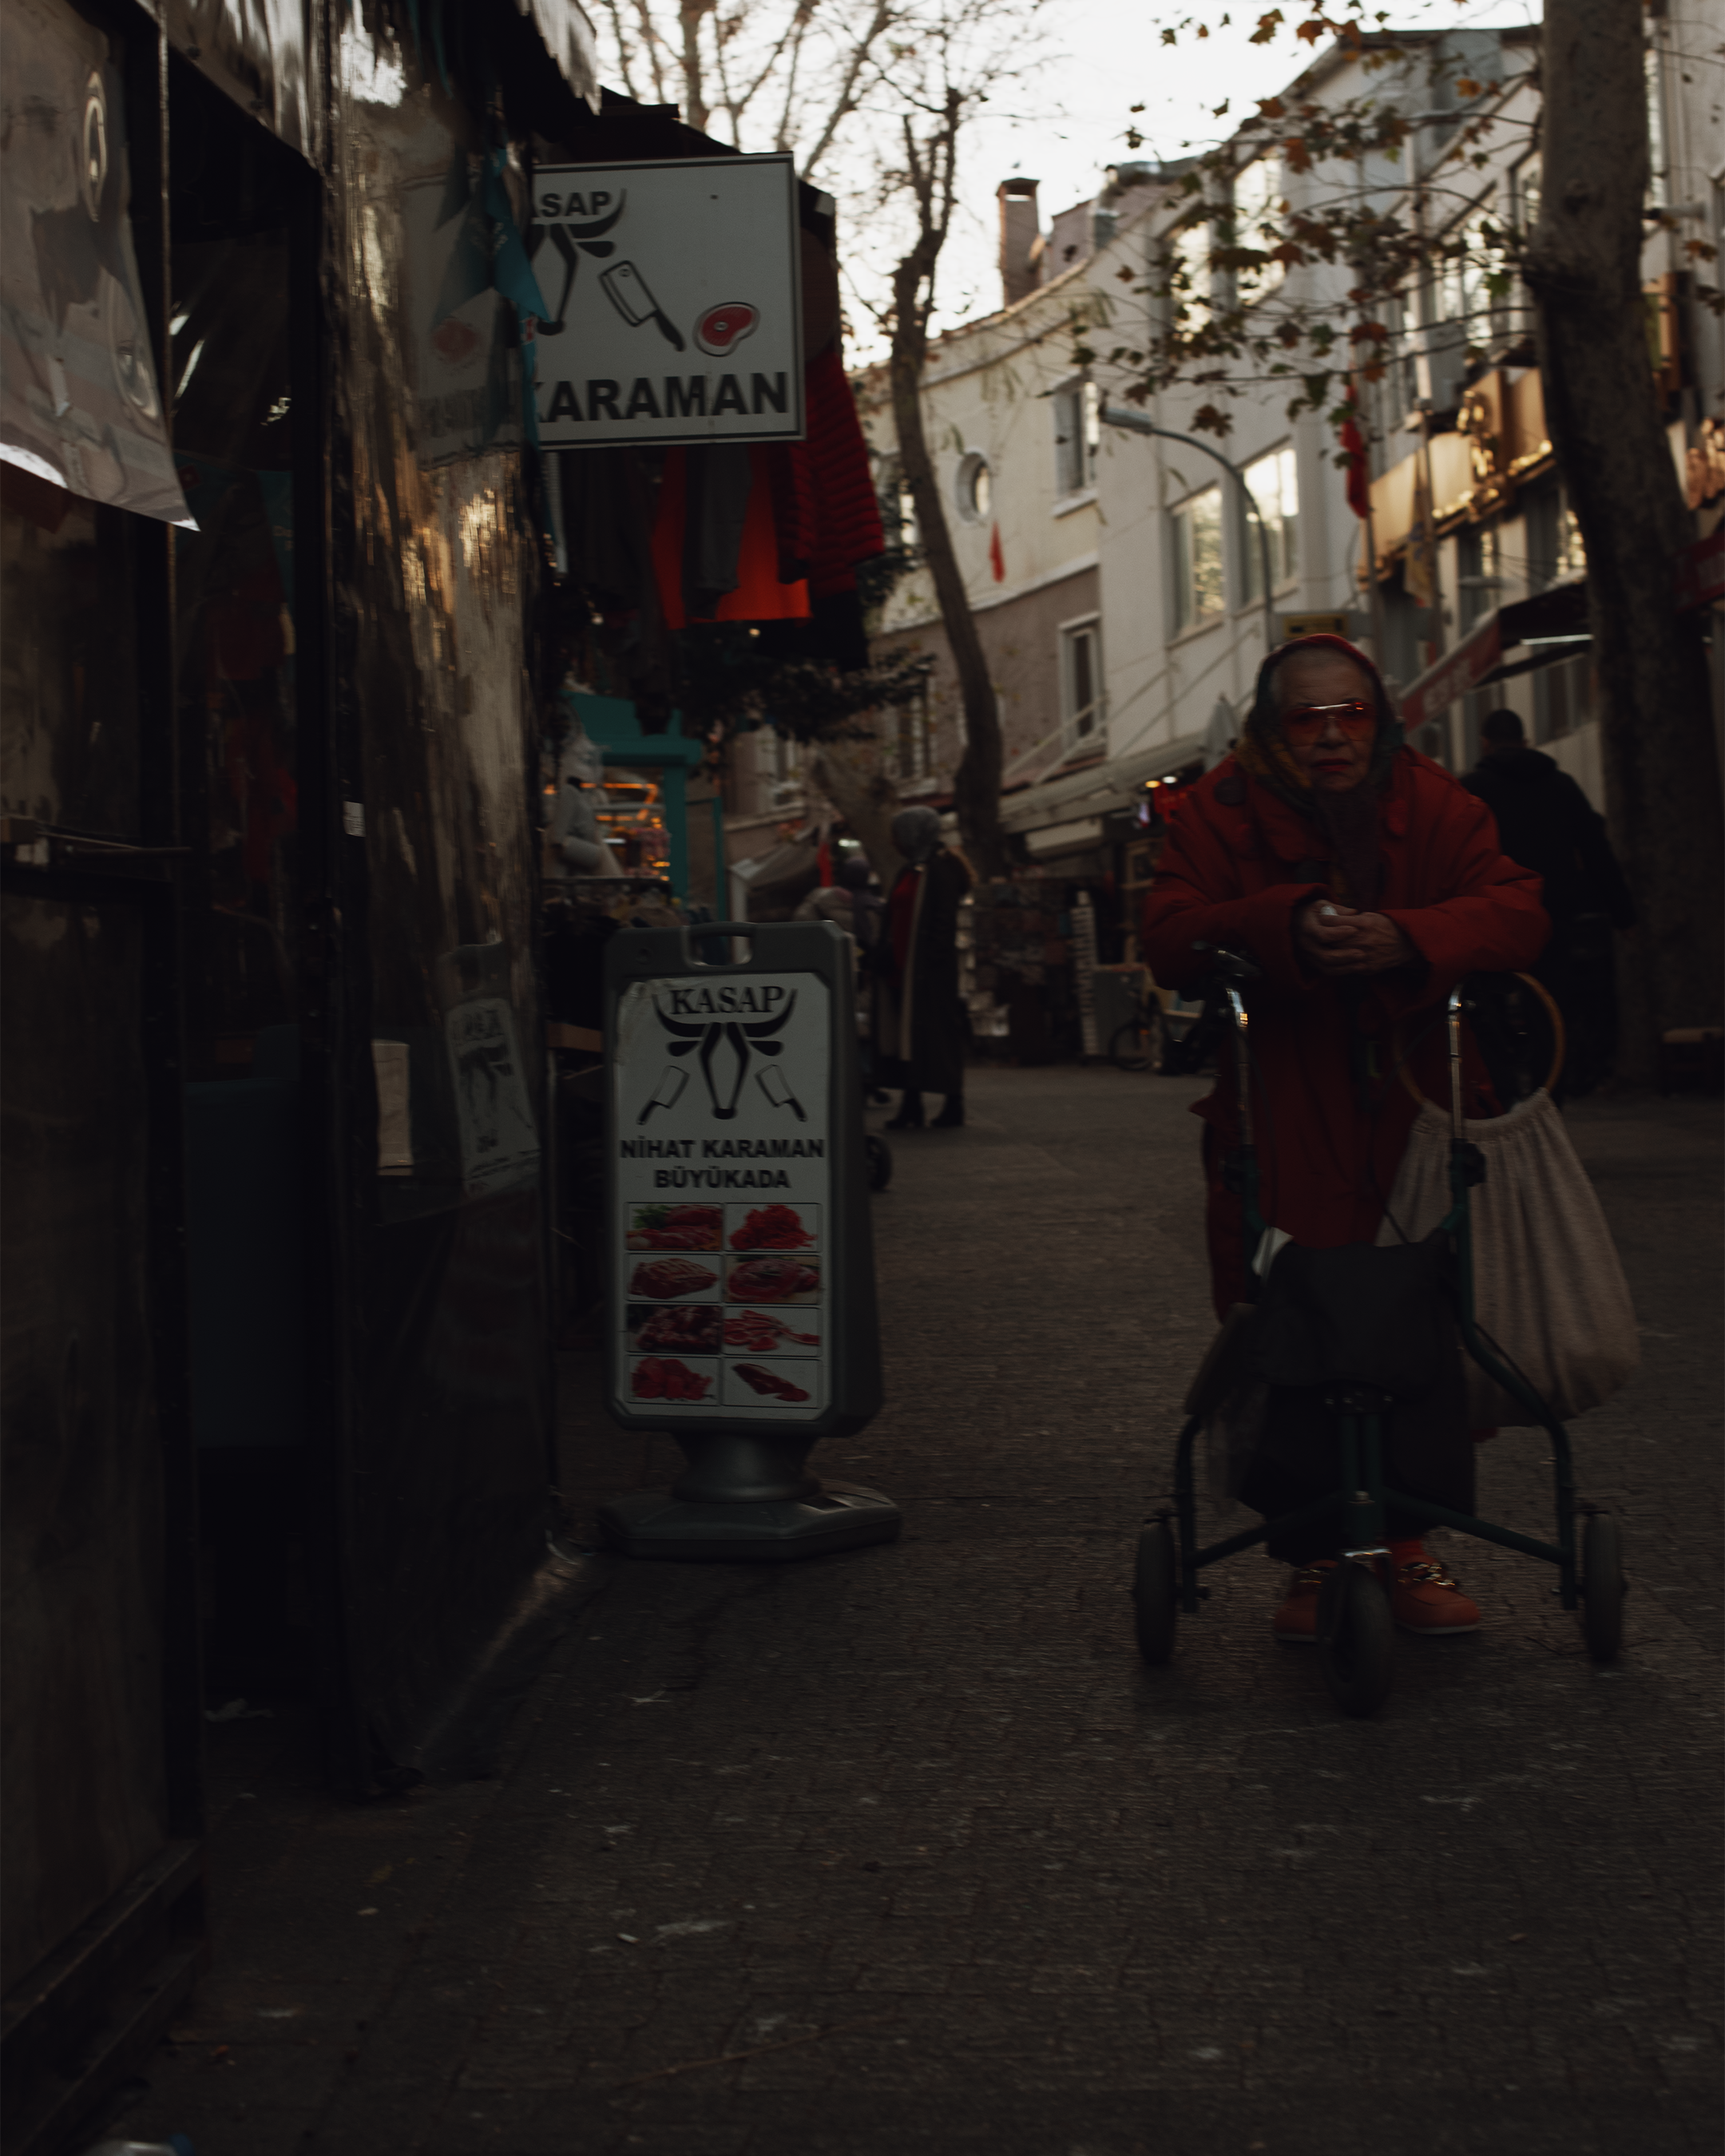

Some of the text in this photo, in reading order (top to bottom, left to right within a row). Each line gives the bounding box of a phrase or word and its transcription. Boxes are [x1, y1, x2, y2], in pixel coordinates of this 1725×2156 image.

[531, 191, 613, 218] SAP
[669, 986, 784, 1015] KASAP
[620, 1135, 824, 1158] NİHAT KARAMAN
[654, 1165, 791, 1188] BÜYÜKADA
